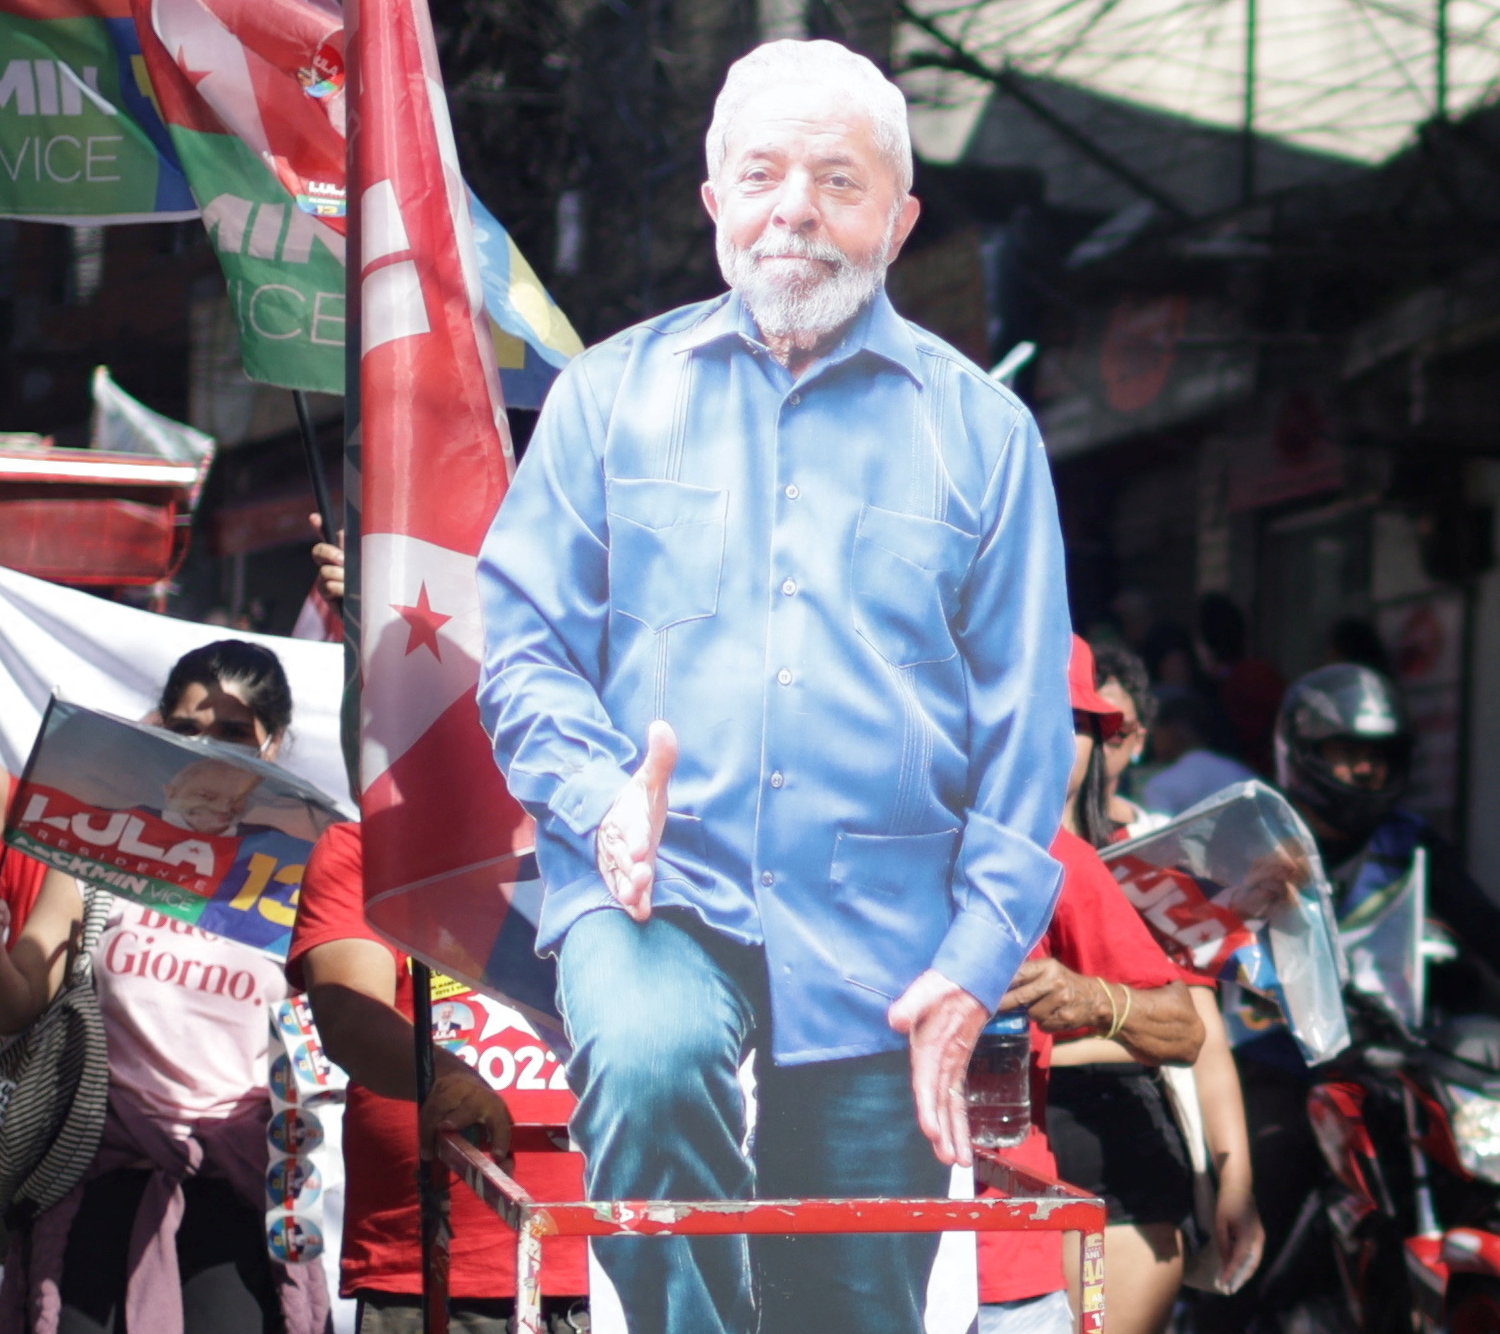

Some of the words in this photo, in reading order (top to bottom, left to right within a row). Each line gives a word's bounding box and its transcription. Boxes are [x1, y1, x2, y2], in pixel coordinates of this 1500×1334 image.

[228, 279, 346, 347] ICE
[18, 821, 208, 894] PRESIDENTE
[21, 793, 216, 878] LULA
[150, 884, 196, 913] VICE
[227, 851, 307, 928] 13
[1112, 865, 1227, 969] ULA
[105, 930, 262, 1006] Giorno.
